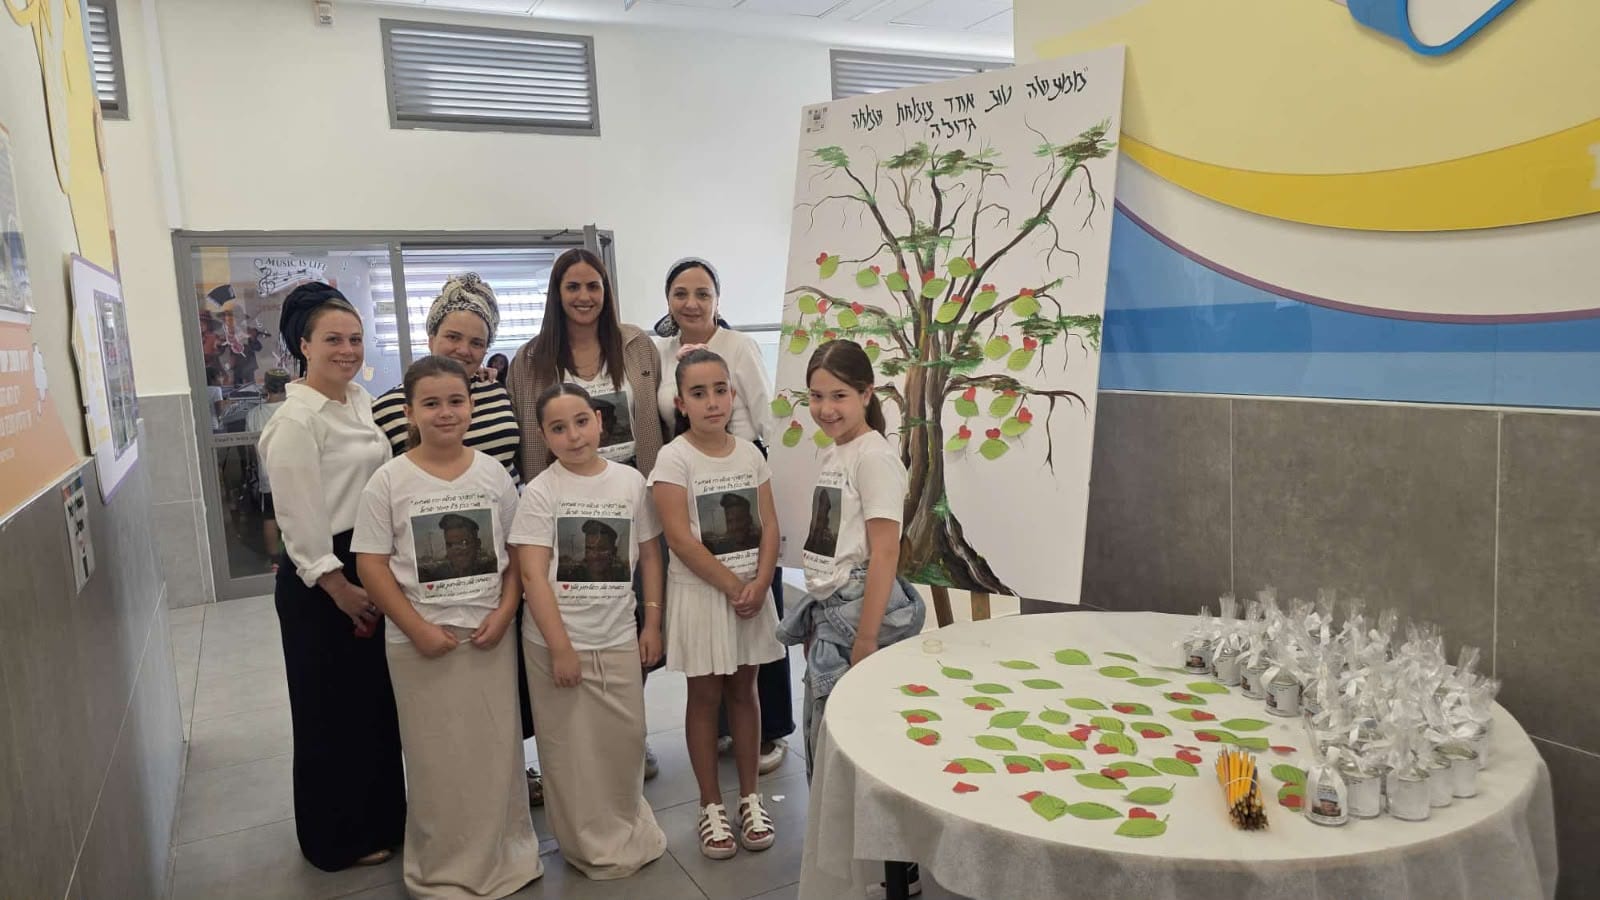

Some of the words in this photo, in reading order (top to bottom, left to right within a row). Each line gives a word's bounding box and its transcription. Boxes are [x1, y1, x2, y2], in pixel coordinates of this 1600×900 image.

[896, 97, 934, 126] צומחת
[944, 93, 975, 114] אחד
[984, 84, 1012, 112] טוב
[851, 104, 883, 131] שמחה
[930, 117, 977, 142] גדולה
